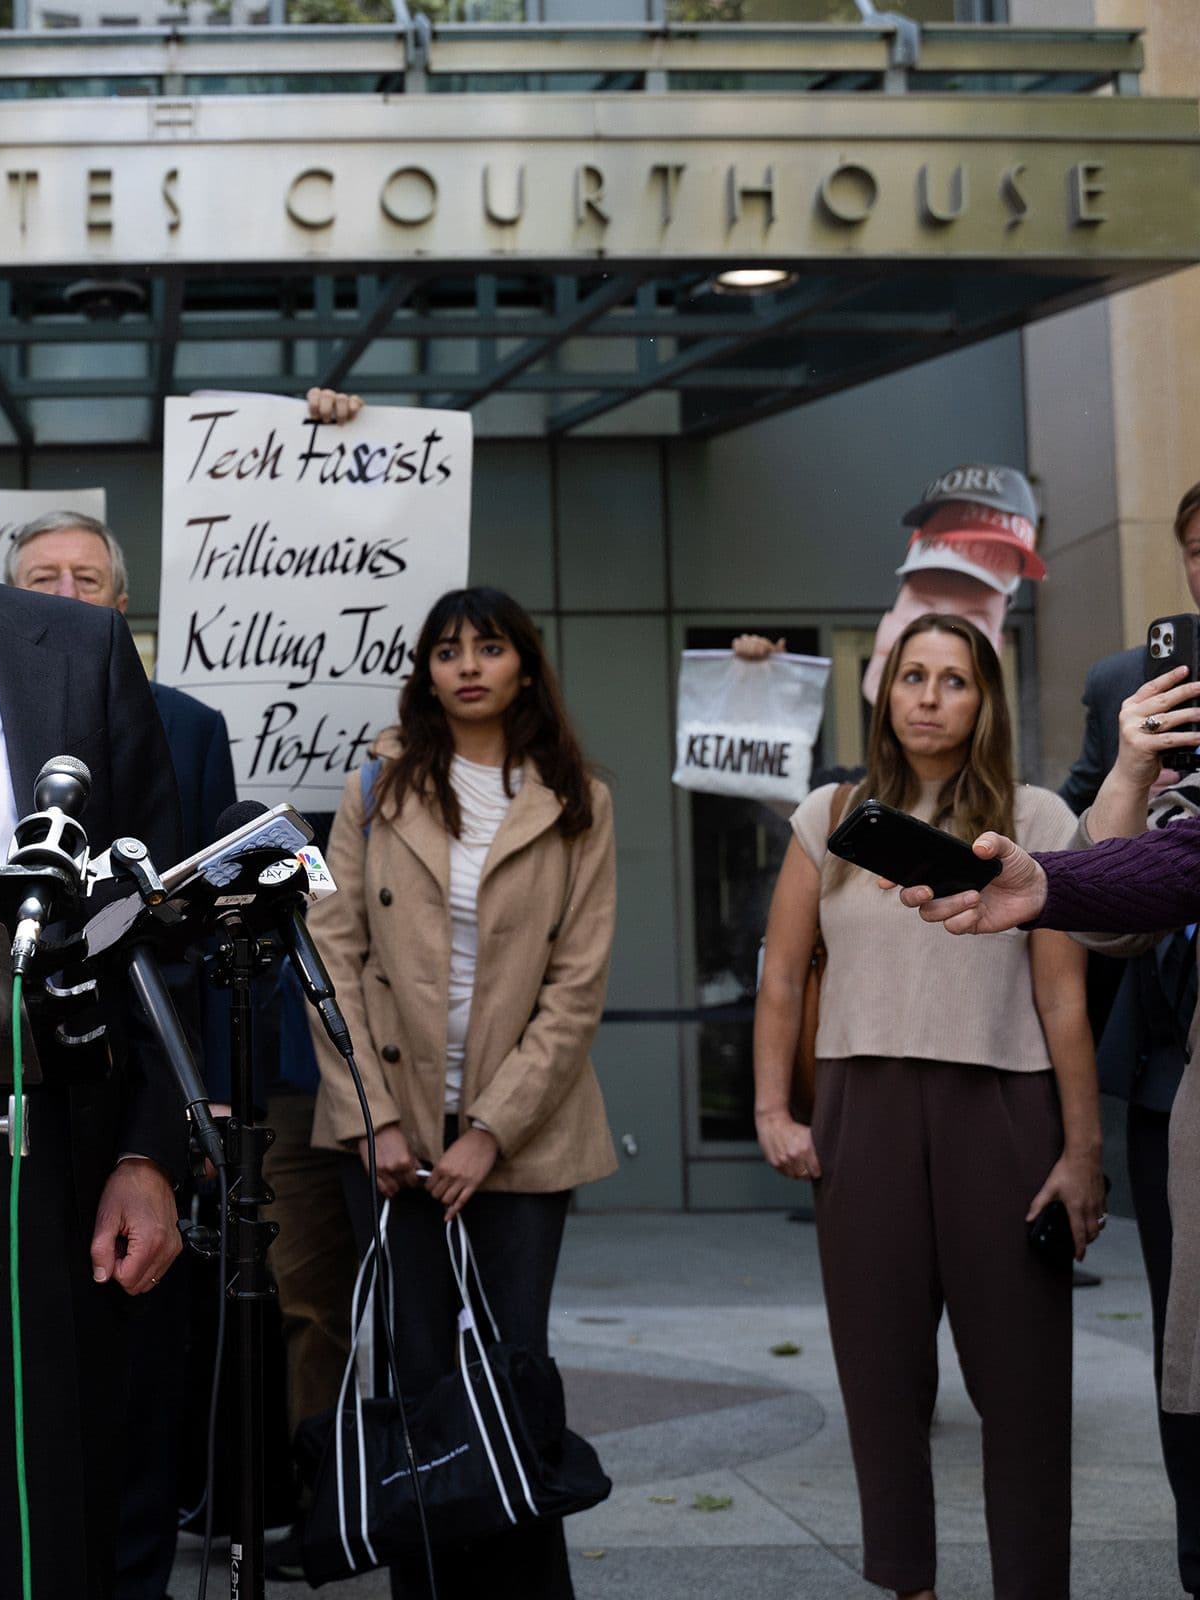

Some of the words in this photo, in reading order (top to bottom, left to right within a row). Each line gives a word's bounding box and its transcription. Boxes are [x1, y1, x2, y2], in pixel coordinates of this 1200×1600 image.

[286, 161, 1107, 232] COURTHOUSE
[187, 410, 286, 482] Tech
[297, 418, 451, 484] Fascists
[186, 515, 408, 582] Trillionaires
[182, 605, 326, 689] Killing
[249, 702, 382, 791] Profit
[685, 734, 792, 777] KETAMINE
